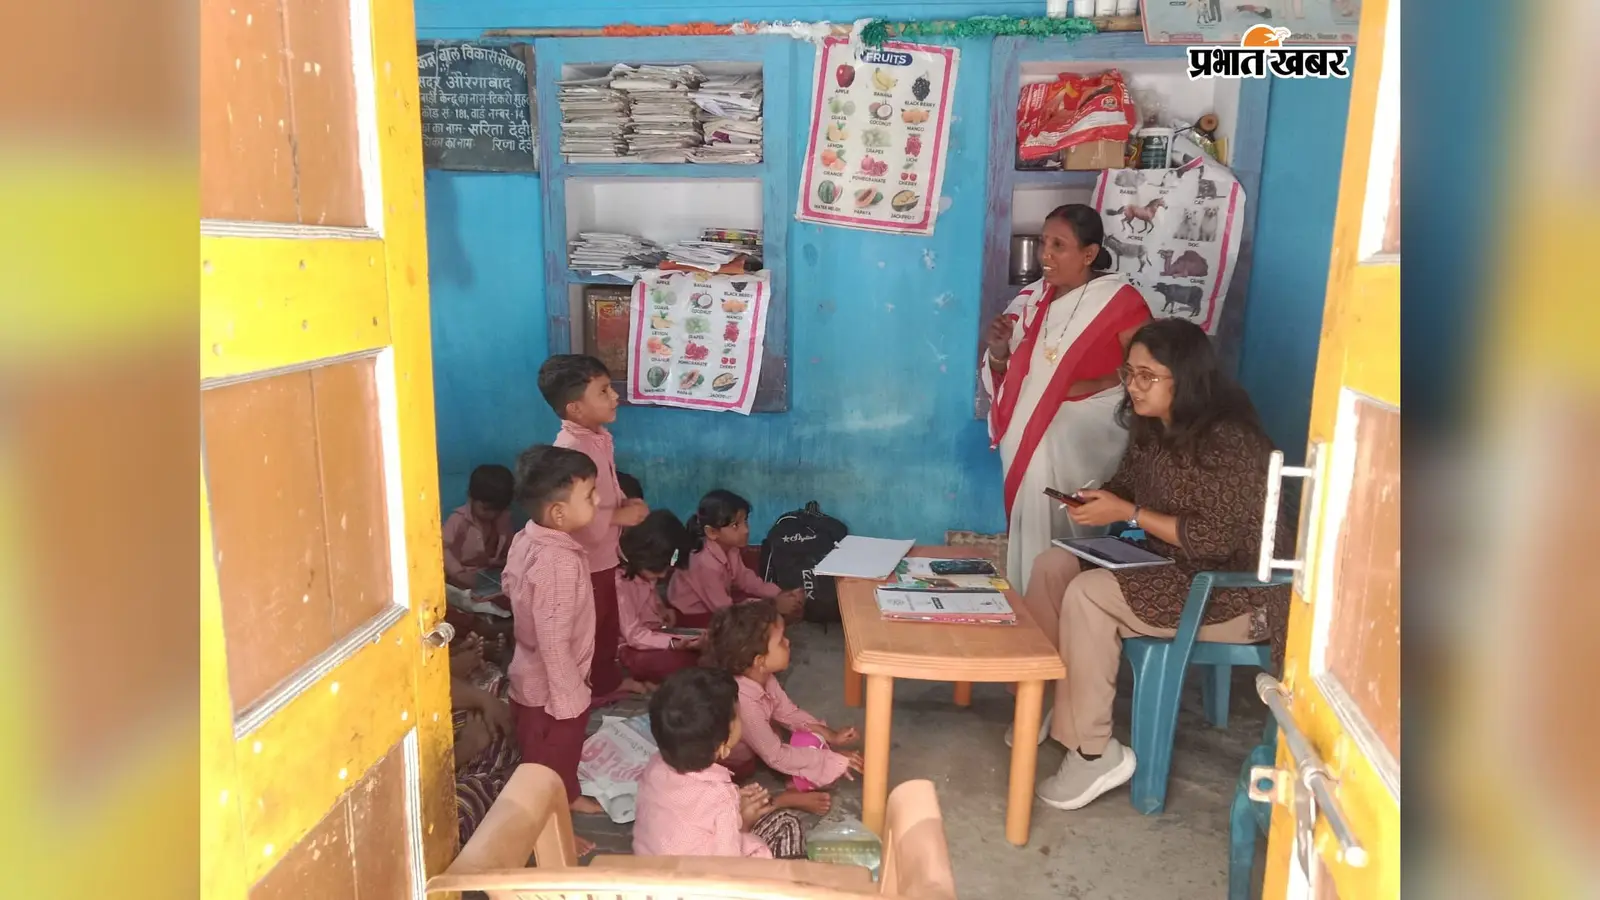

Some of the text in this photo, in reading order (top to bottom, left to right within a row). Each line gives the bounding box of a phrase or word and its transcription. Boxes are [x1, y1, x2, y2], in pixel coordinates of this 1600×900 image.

[461, 44, 498, 65] विकास
[865, 51, 907, 65] FRUITS
[467, 119, 505, 138] सरिता
[869, 119, 892, 127] COCONUT
